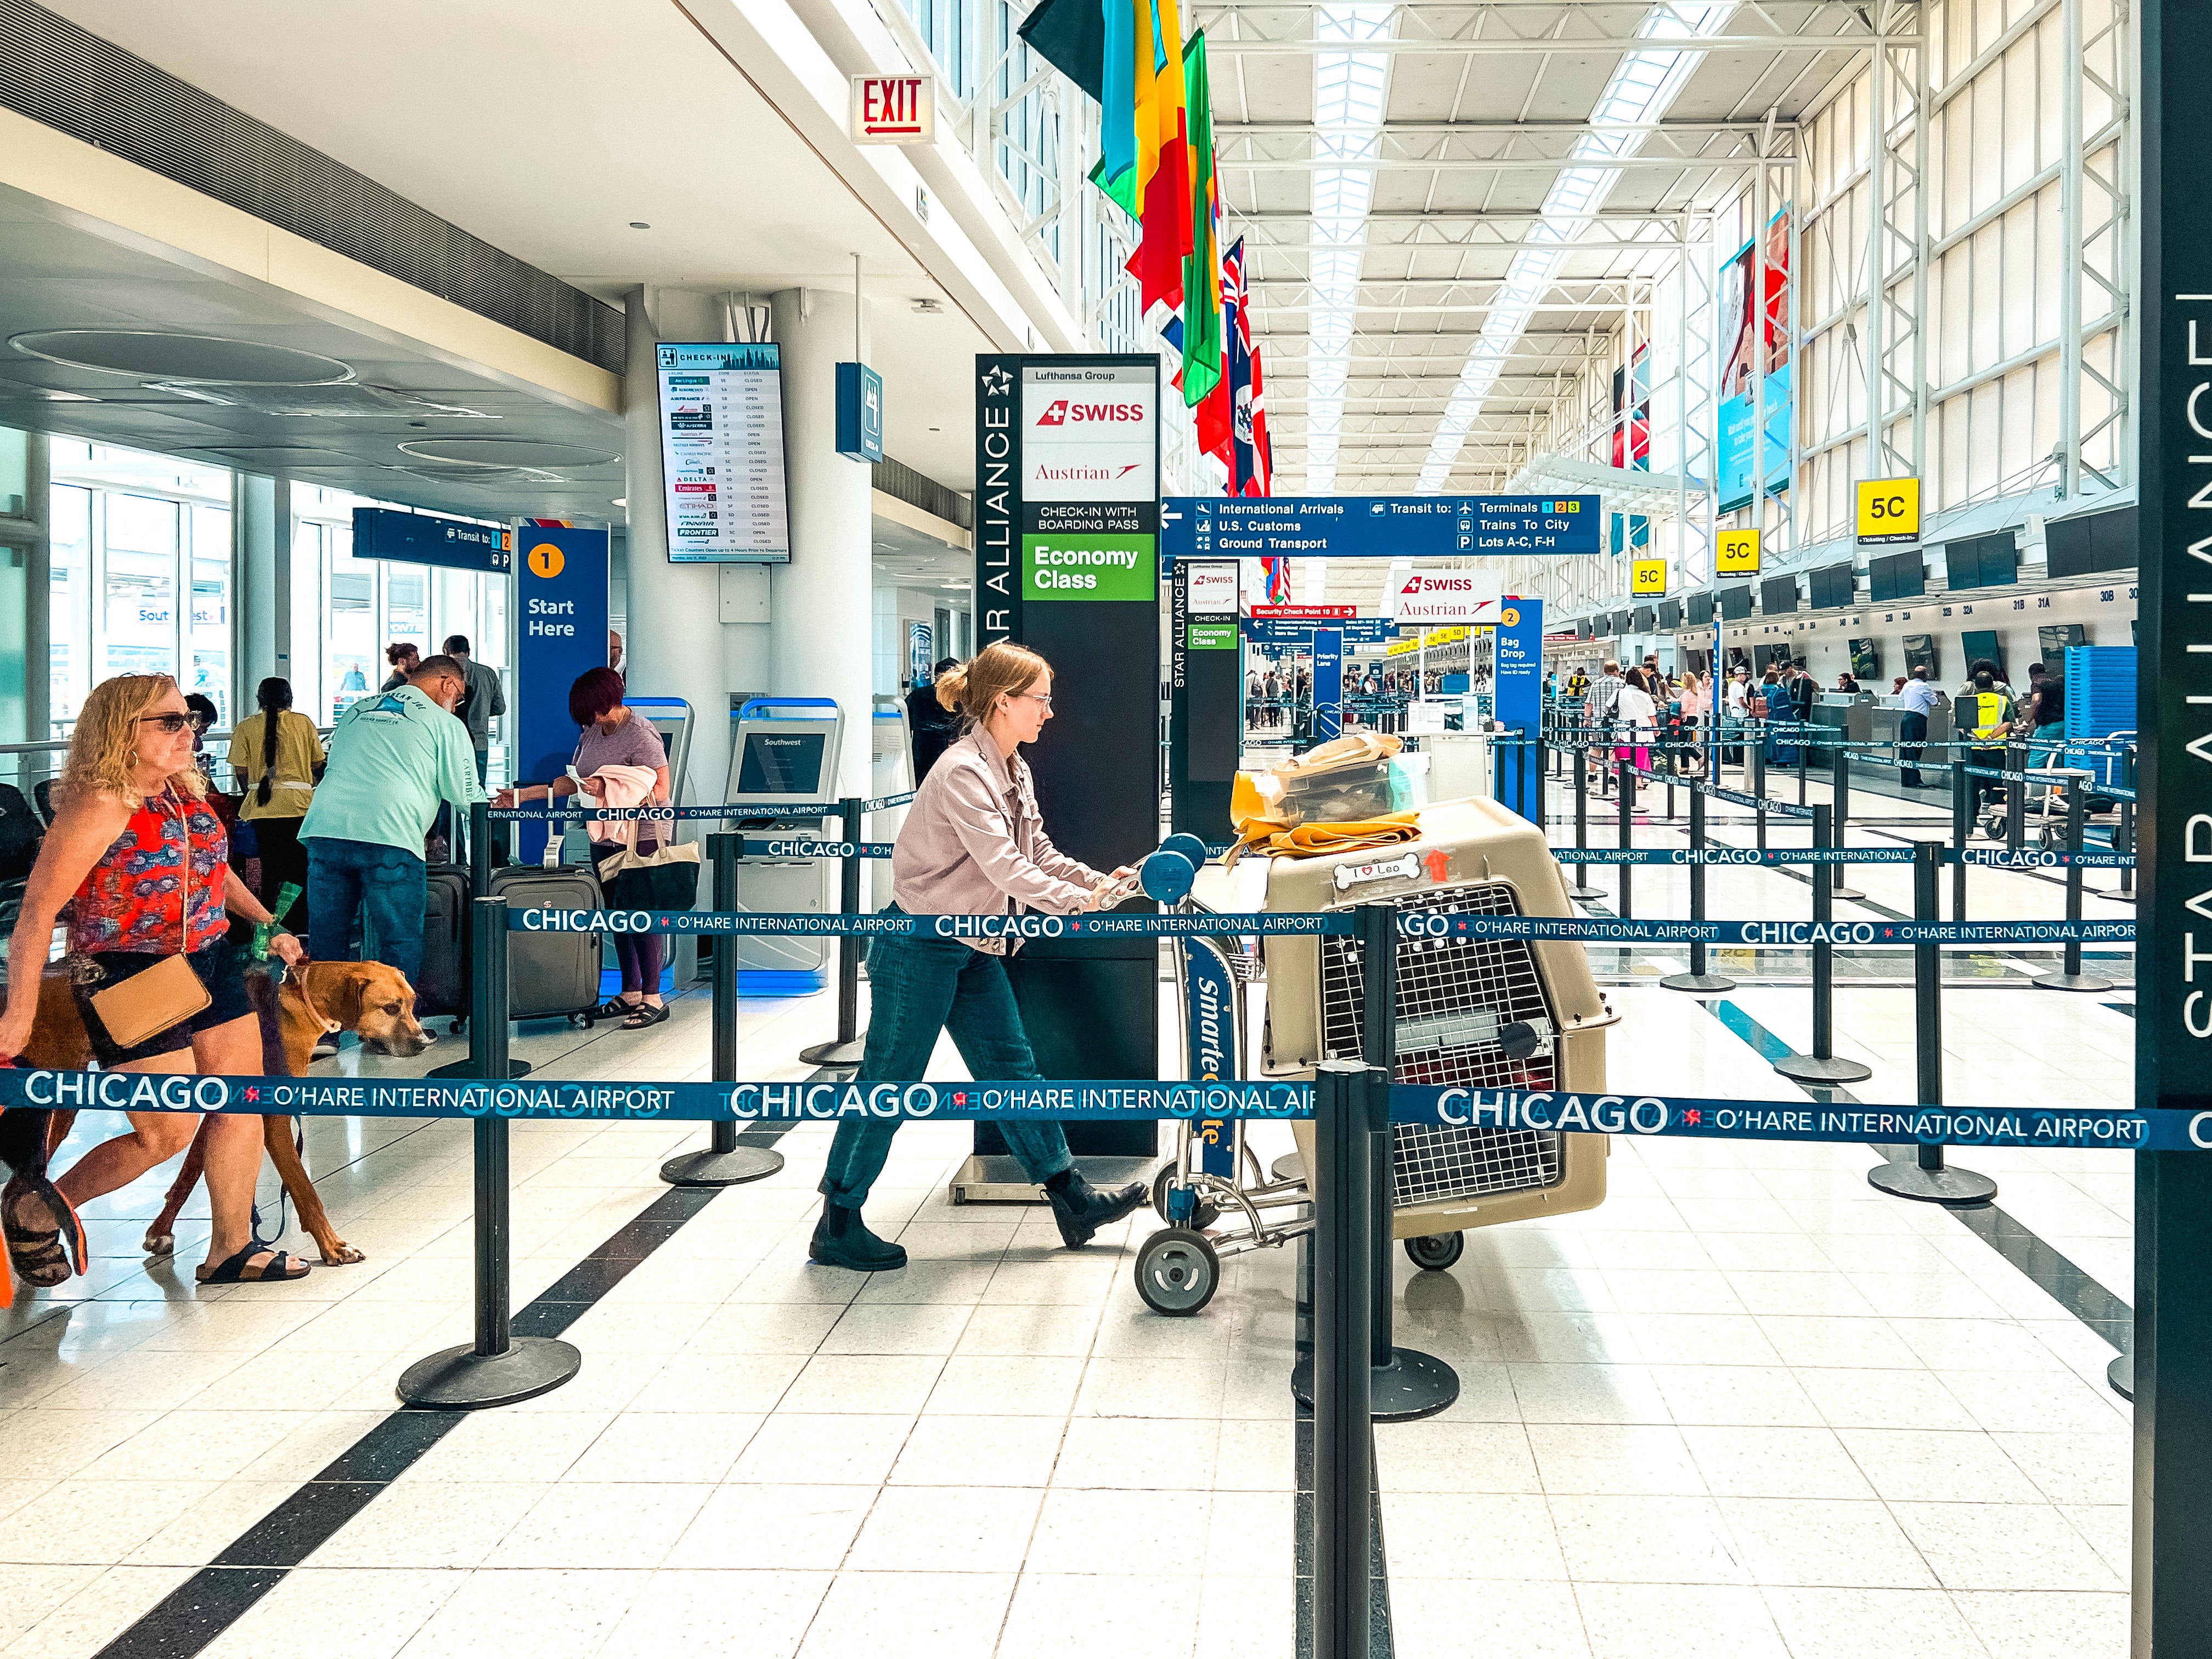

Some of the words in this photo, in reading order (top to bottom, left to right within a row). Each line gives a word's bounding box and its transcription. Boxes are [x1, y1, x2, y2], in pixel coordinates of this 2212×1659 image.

[864, 80, 922, 122] EXIT
[1035, 371, 1082, 380] Lufthansa
[1085, 372, 1115, 381] Group
[1071, 404, 1144, 421] SWISS
[1035, 464, 1110, 481] Austrian
[985, 408, 1010, 595] ALLIANCE
[1219, 503, 1294, 515] International
[1300, 503, 1344, 515] Arrivals
[1391, 503, 1431, 514] Transit
[1436, 504, 1452, 515] to:
[1480, 502, 1538, 513] Terminals
[1545, 503, 1550, 513] 1
[1557, 503, 1564, 513] 2
[1570, 503, 1577, 513] 3
[1871, 496, 1905, 518] 5C
[1040, 506, 1102, 517] CHECK-IN
[1105, 506, 1137, 517] WITH
[1038, 519, 1104, 530] BOARDING
[1107, 519, 1139, 530] PASS
[1219, 521, 1243, 532] U.S.
[1248, 520, 1301, 532] Customs
[1480, 520, 1519, 531] Trains
[1523, 520, 1538, 530] To
[1544, 520, 1570, 532] City
[457, 529, 479, 543] Transit
[482, 533, 491, 544] to:
[493, 532, 498, 546] 1
[504, 535, 510, 548] 2
[1219, 537, 1265, 549] Ground
[1270, 537, 1327, 551] Transport
[1479, 537, 1504, 548] Lots
[1507, 537, 1531, 549] A-C,
[1536, 536, 1555, 548] F-H
[1034, 545, 1139, 569] Economy
[1726, 542, 1750, 558] 5C
[541, 552, 550, 569] 1
[1034, 569, 1098, 589] Class
[1424, 578, 1472, 591] SWISS
[1640, 571, 1658, 583] 5C
[2038, 597, 2050, 608] 31A
[2100, 590, 2114, 602] 30B
[528, 598, 574, 615] Start
[1400, 601, 1467, 616] Austrian
[1943, 607, 1952, 617] 32B
[1963, 605, 1973, 615] 32A
[2013, 599, 2025, 611] 31B
[1175, 578, 1185, 648] ALLIANCE
[1507, 613, 1514, 622] 2
[1902, 612, 1911, 620] 33A
[529, 620, 575, 636] Here
[1192, 628, 1232, 637] Economy
[1500, 637, 1519, 648] Bag
[1500, 649, 1526, 660] Drop
[1175, 652, 1185, 688] STAR
[364, 692, 413, 702] CARIBBEAN
[412, 701, 426, 710] JOE
[488, 811, 544, 819] ERNATIONAL
[545, 811, 583, 819] AIRPORT
[596, 808, 675, 821] CHICAGO
[690, 809, 721, 817] O'HARE
[723, 807, 790, 817] INTERNATIONAL
[792, 806, 828, 815] AIRPORT
[768, 842, 855, 858] CHICAGO
[1604, 851, 1649, 862] AIRPORT
[1671, 849, 1762, 865] CHICAGO
[1780, 851, 1821, 861] O'HARE
[1823, 850, 1907, 861] INTERNATIONAL
[1961, 849, 2057, 867] CHICAGO
[2075, 854, 2115, 865] O'HARE
[1354, 868, 1357, 878] I
[1378, 864, 1400, 875] Leo
[522, 909, 652, 933] CHICAGO
[677, 916, 731, 930] O'HARE
[735, 917, 850, 932] INTERNATIONAL
[853, 918, 913, 933] AIRPORT
[934, 915, 1063, 938] CHICAGO
[1088, 918, 1144, 933] O'HARE
[1146, 917, 1260, 933] INTERNATIONAL
[1263, 916, 1323, 931] AIRPORT
[1475, 920, 1532, 935] O'HARE
[1534, 922, 1653, 938] INTERNATIONAL
[1656, 924, 1718, 939] AIRPORT
[1741, 921, 1875, 945] CHICAGO
[1901, 926, 1956, 940] O'HARE
[1960, 924, 2079, 940] INTERNATIONAL
[24, 1070, 229, 1111] CHICAGO
[274, 1085, 364, 1107] O'HARE
[371, 1086, 564, 1109] INTERNATIONAL
[571, 1088, 675, 1110] AIRPORT
[730, 1082, 938, 1118] CHICAGO
[983, 1089, 1074, 1110] O'HARE
[1082, 1089, 1278, 1110] INTERNATIONAL
[1437, 1087, 1669, 1134] CHICAGO
[1716, 1109, 1812, 1131] O'HARE
[1821, 1112, 2028, 1137] INTERNATIONAL
[2034, 1118, 2147, 1140] AIRPORT
